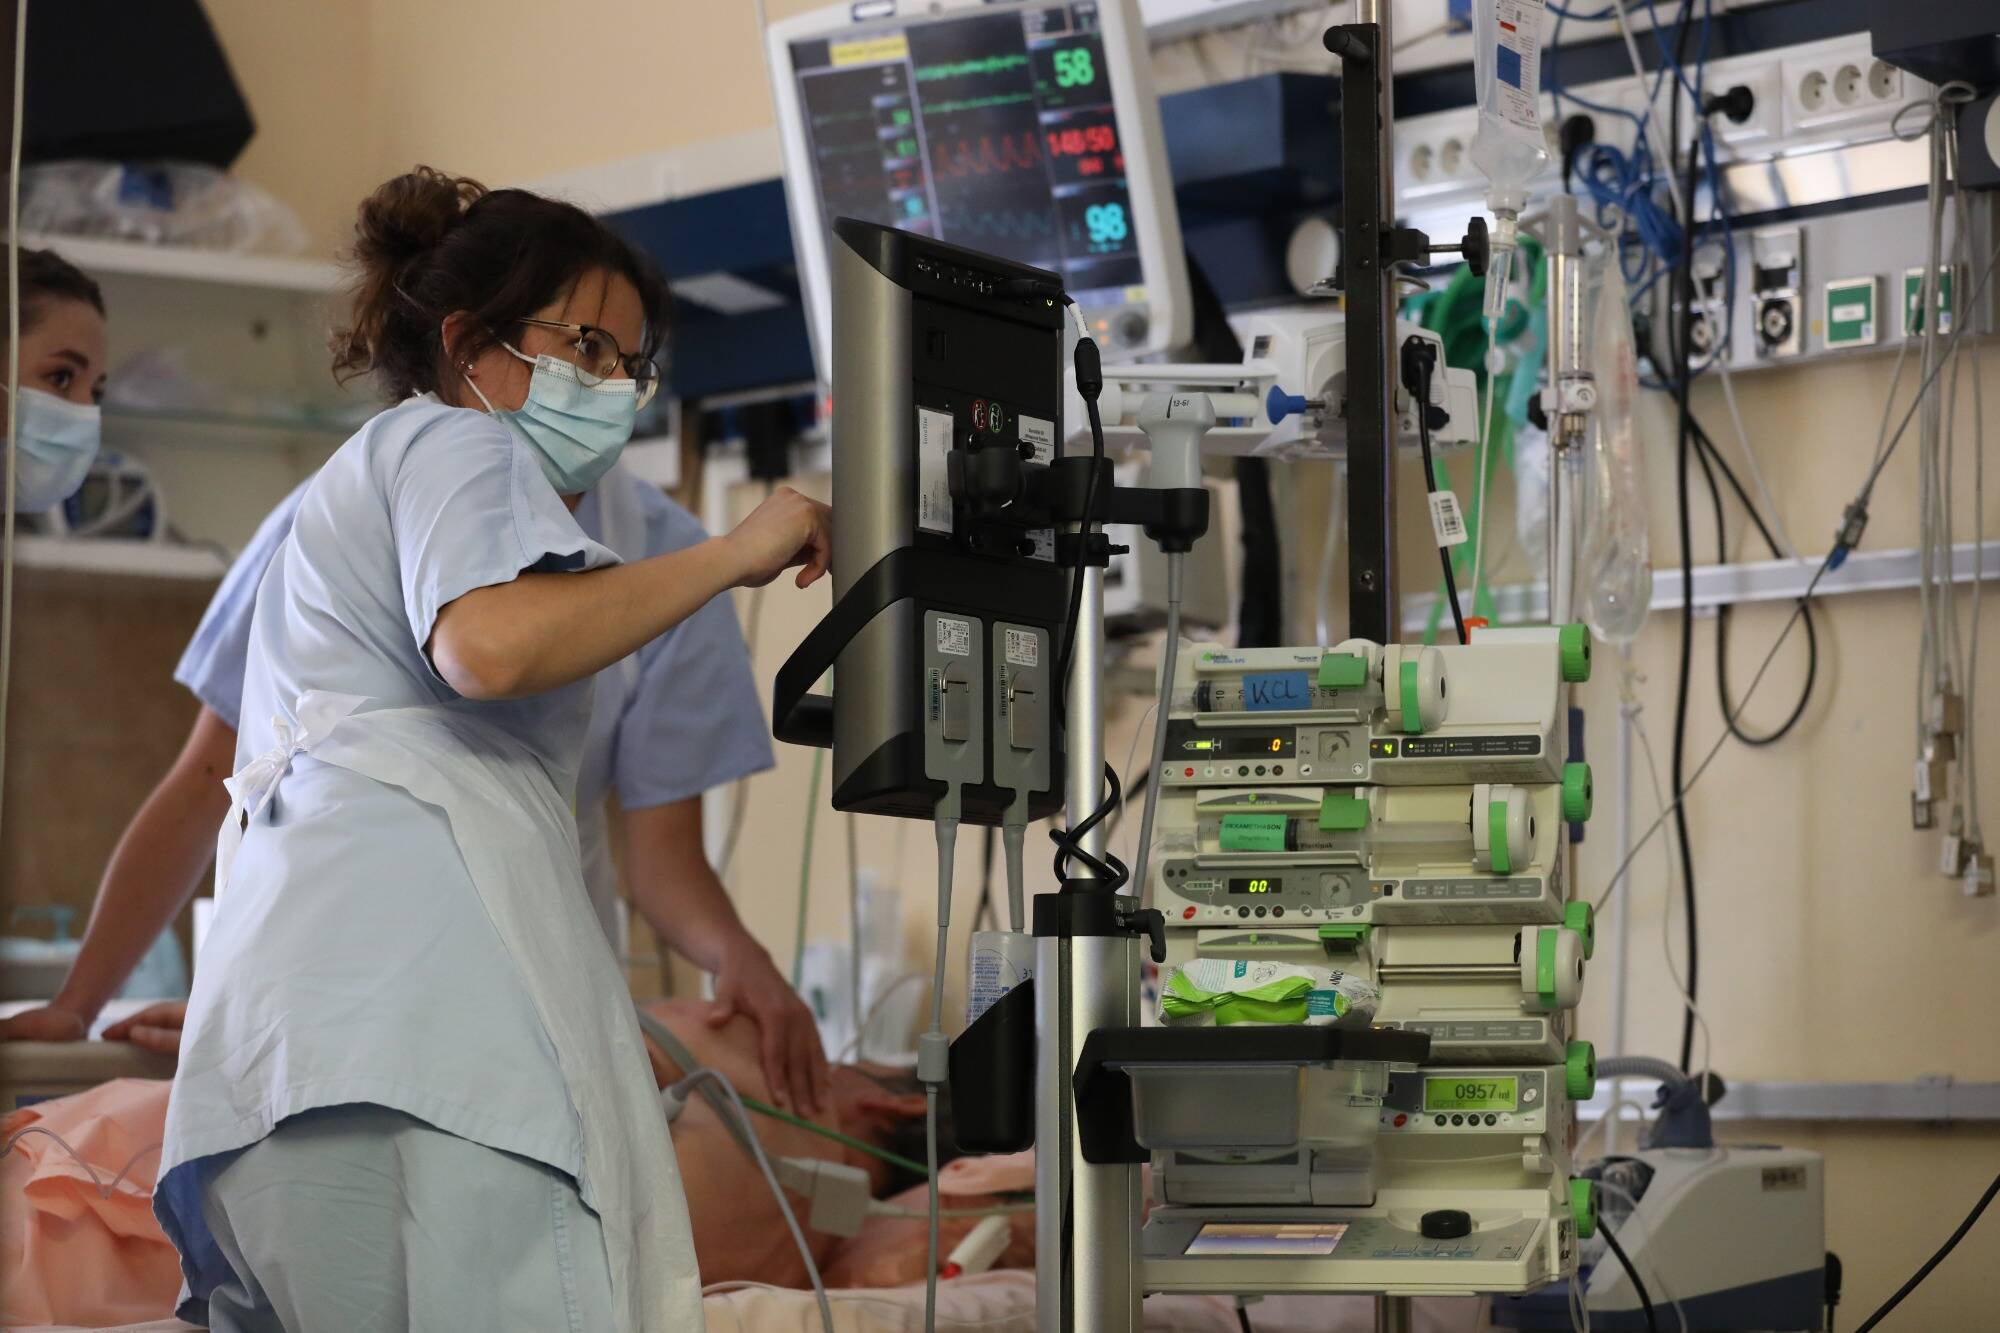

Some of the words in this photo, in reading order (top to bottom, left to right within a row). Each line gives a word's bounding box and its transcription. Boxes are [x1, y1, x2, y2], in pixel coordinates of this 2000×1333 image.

[1053, 47, 1095, 87] 58
[1085, 202, 1127, 242] 98
[1384, 744, 1393, 755] 4
[1455, 1084, 1497, 1100] 0957
